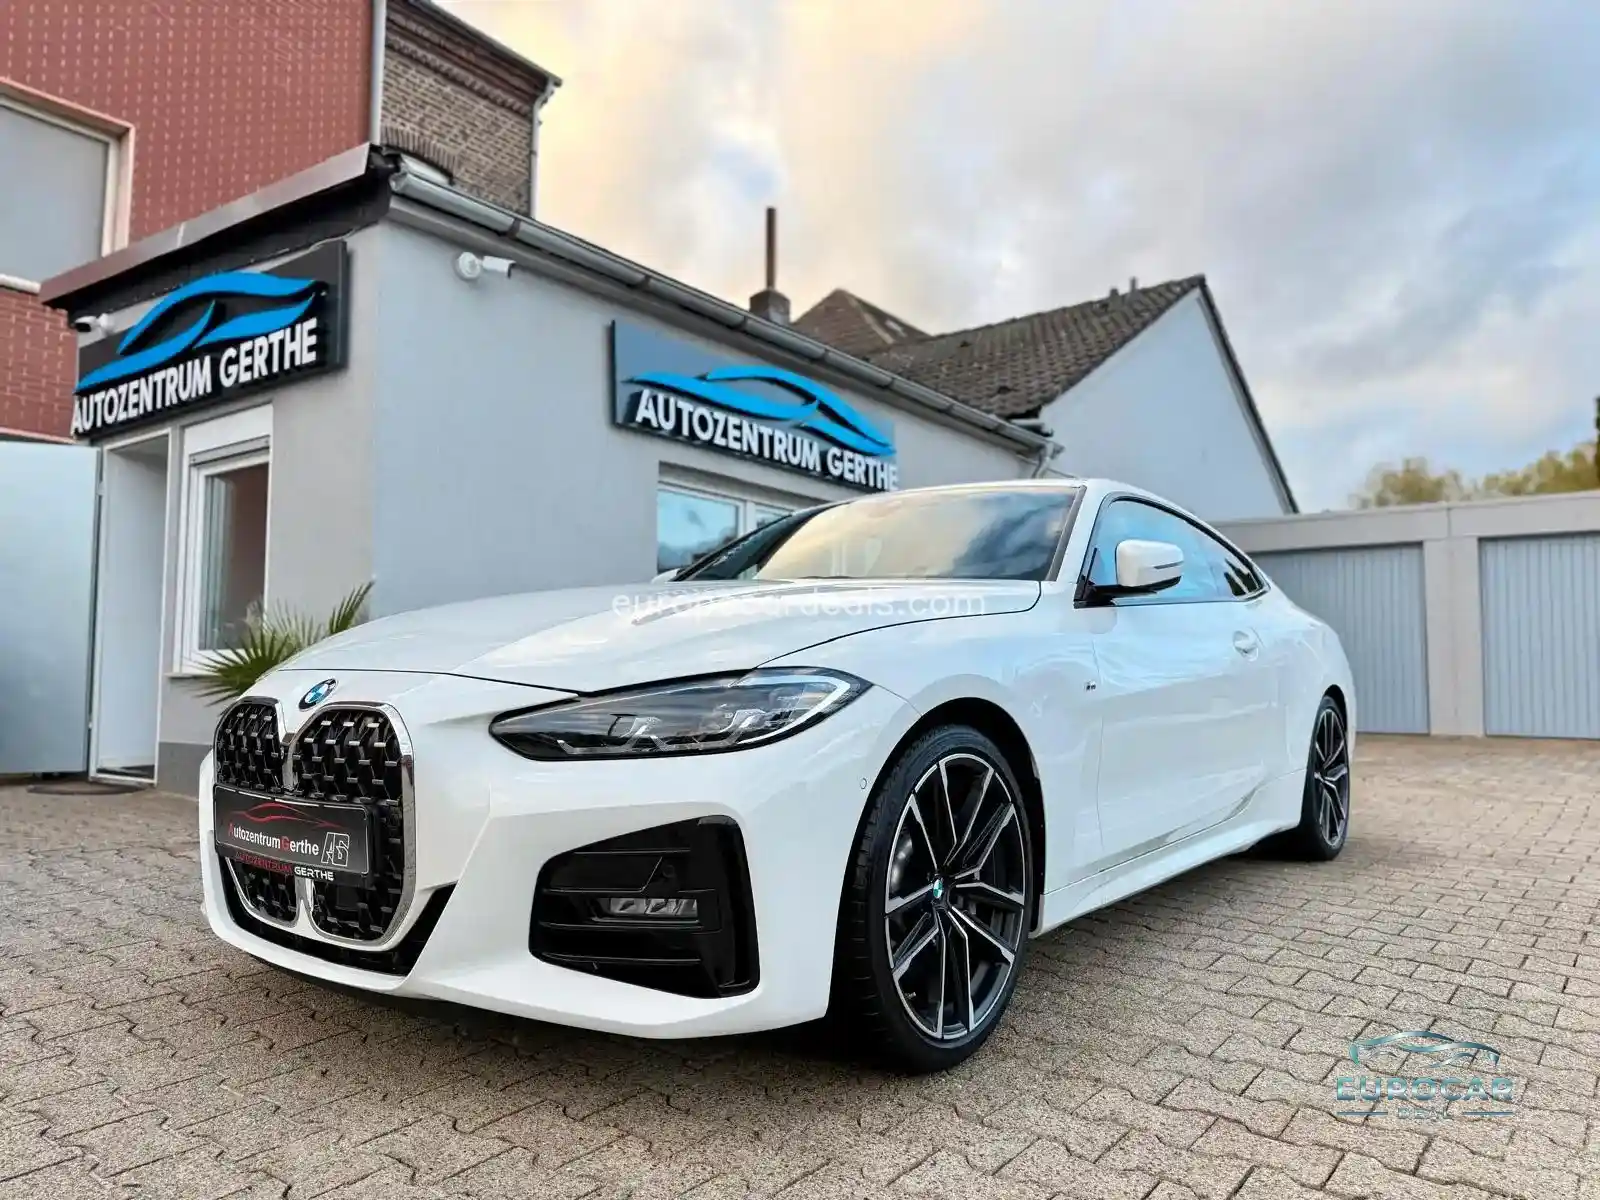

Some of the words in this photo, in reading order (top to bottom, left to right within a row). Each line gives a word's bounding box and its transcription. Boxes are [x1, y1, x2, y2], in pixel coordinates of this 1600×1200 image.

[71, 356, 212, 434] AUTOZENTRUM
[219, 317, 318, 388] GERTHE
[635, 389, 821, 472] AUTOZENTRUM
[827, 446, 899, 491] GERTHE
[294, 866, 334, 880] GERTHE
